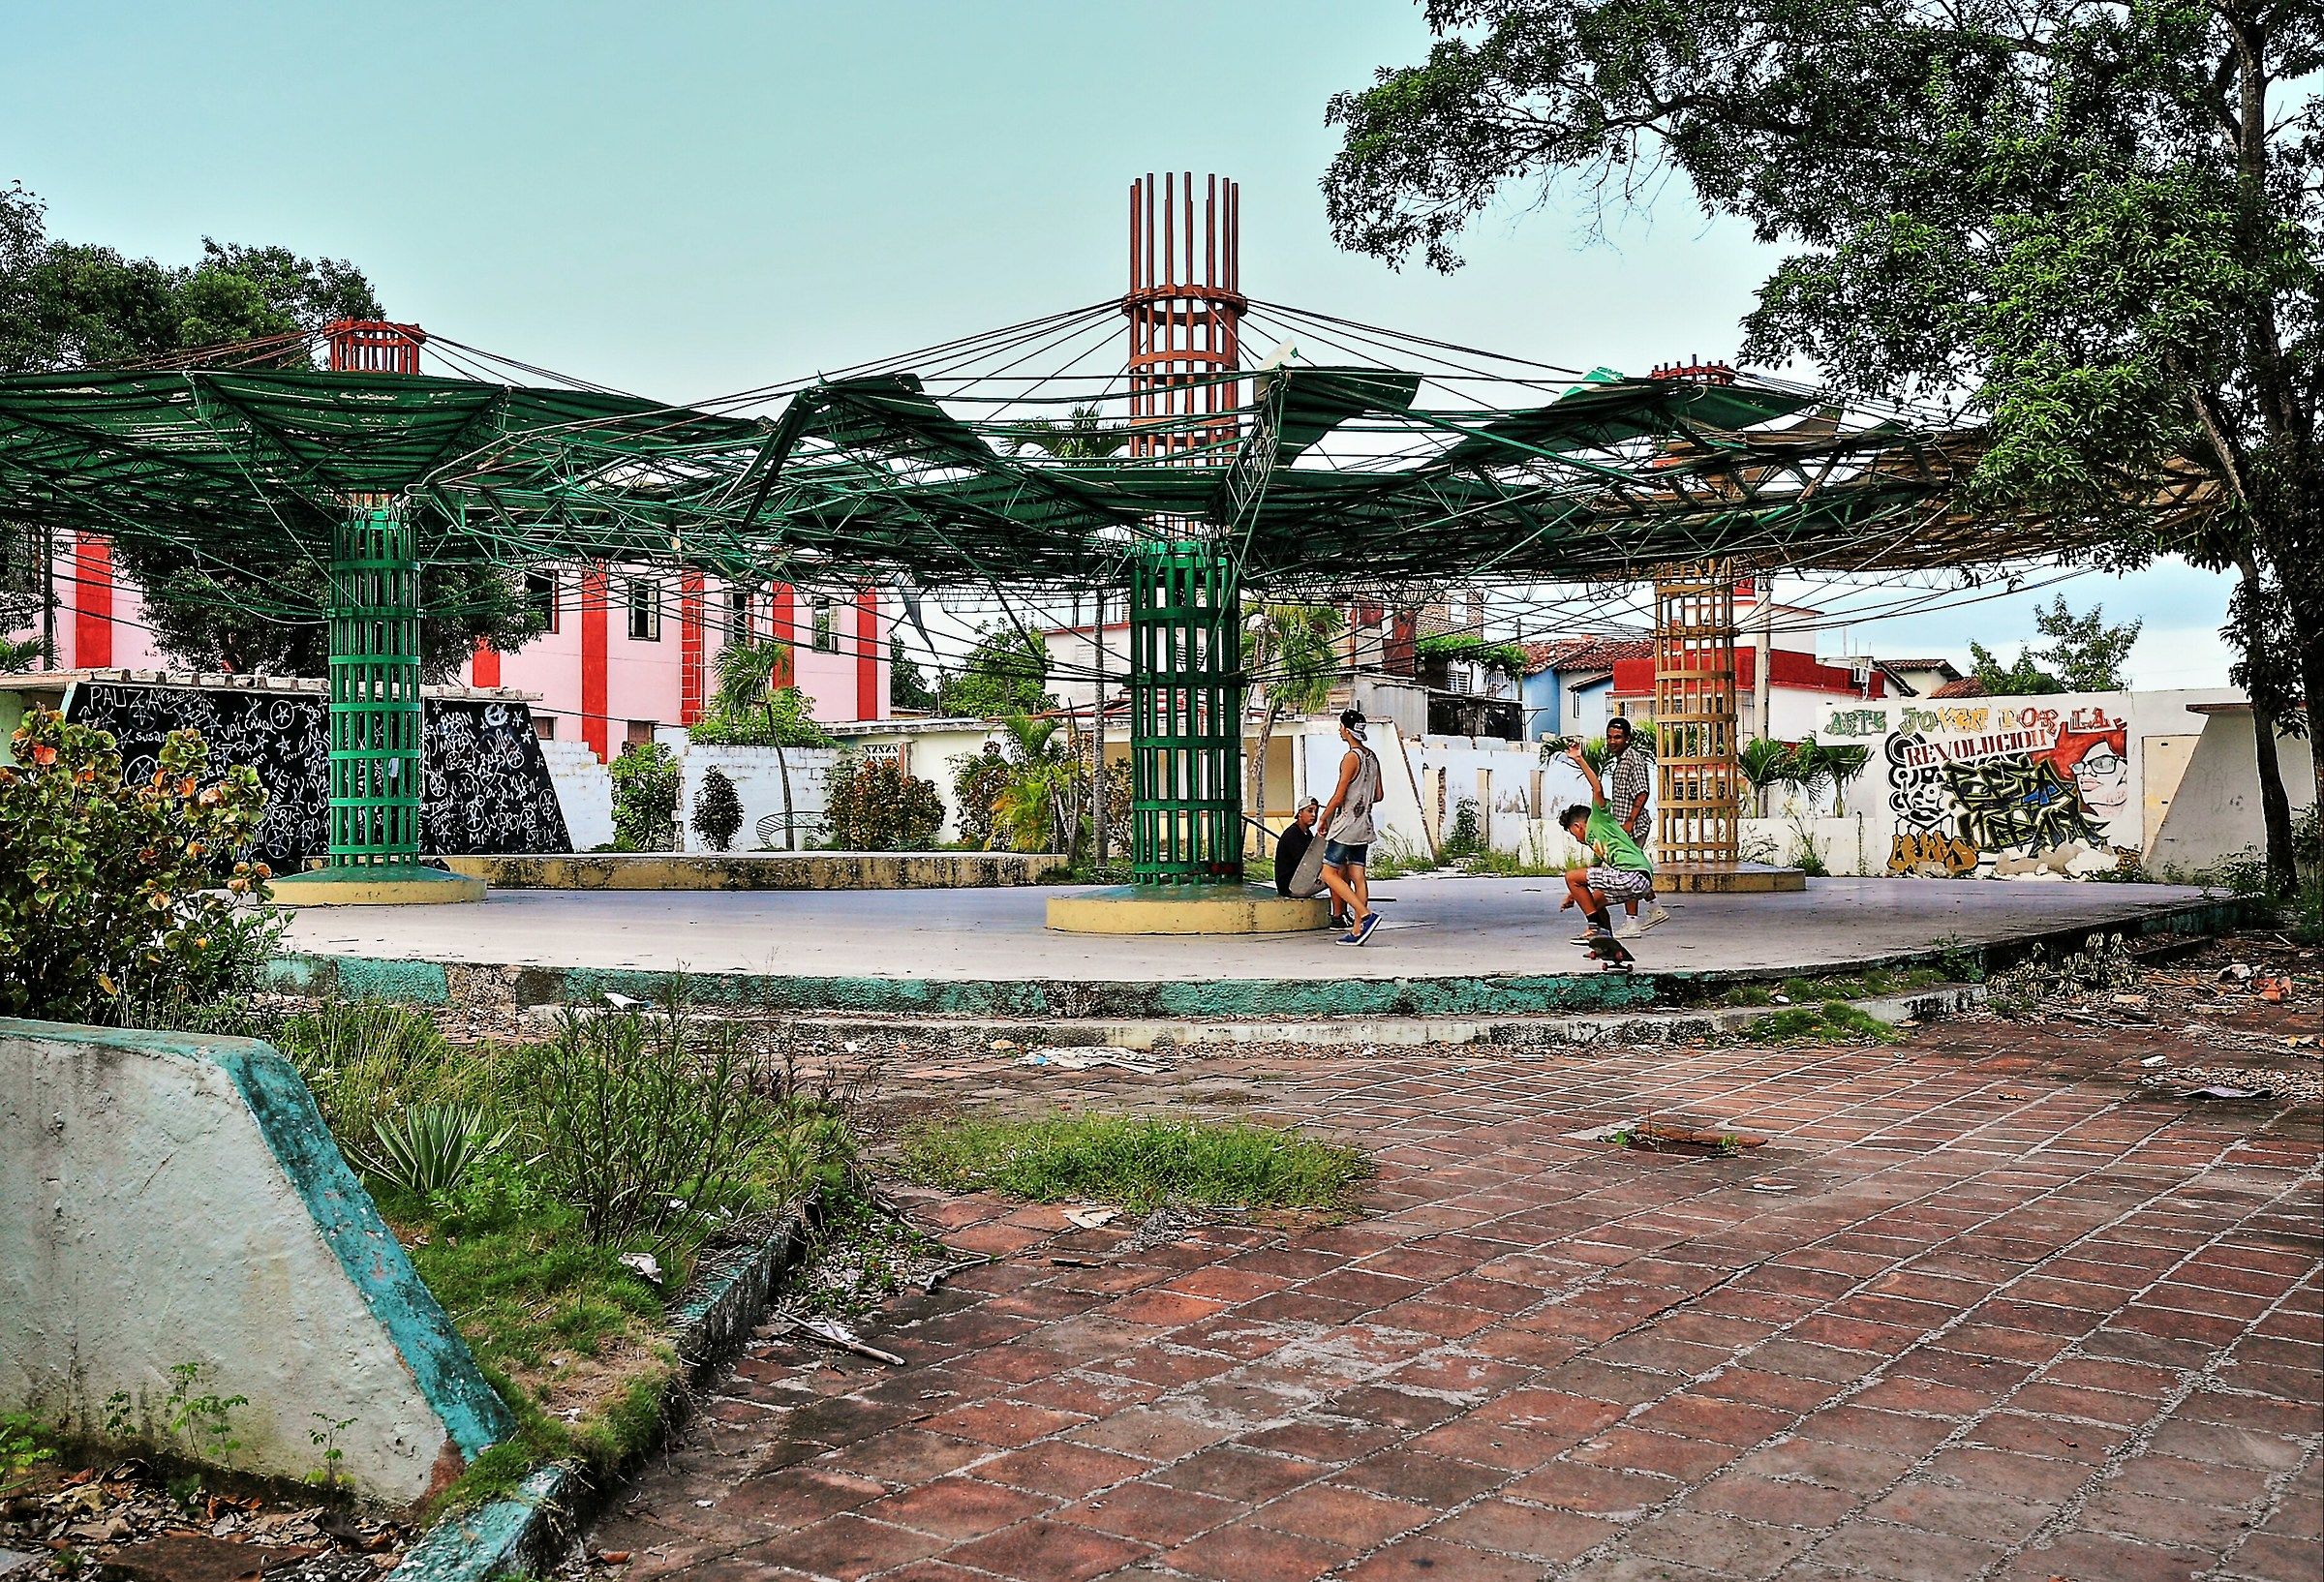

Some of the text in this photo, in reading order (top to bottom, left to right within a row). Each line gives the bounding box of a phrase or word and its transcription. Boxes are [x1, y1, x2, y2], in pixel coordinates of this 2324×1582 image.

[90, 685, 163, 712] PAUZA
[1823, 710, 1887, 738] ARTE
[1999, 707, 2059, 737] POR
[1906, 728, 2048, 768] REVOLUCION
